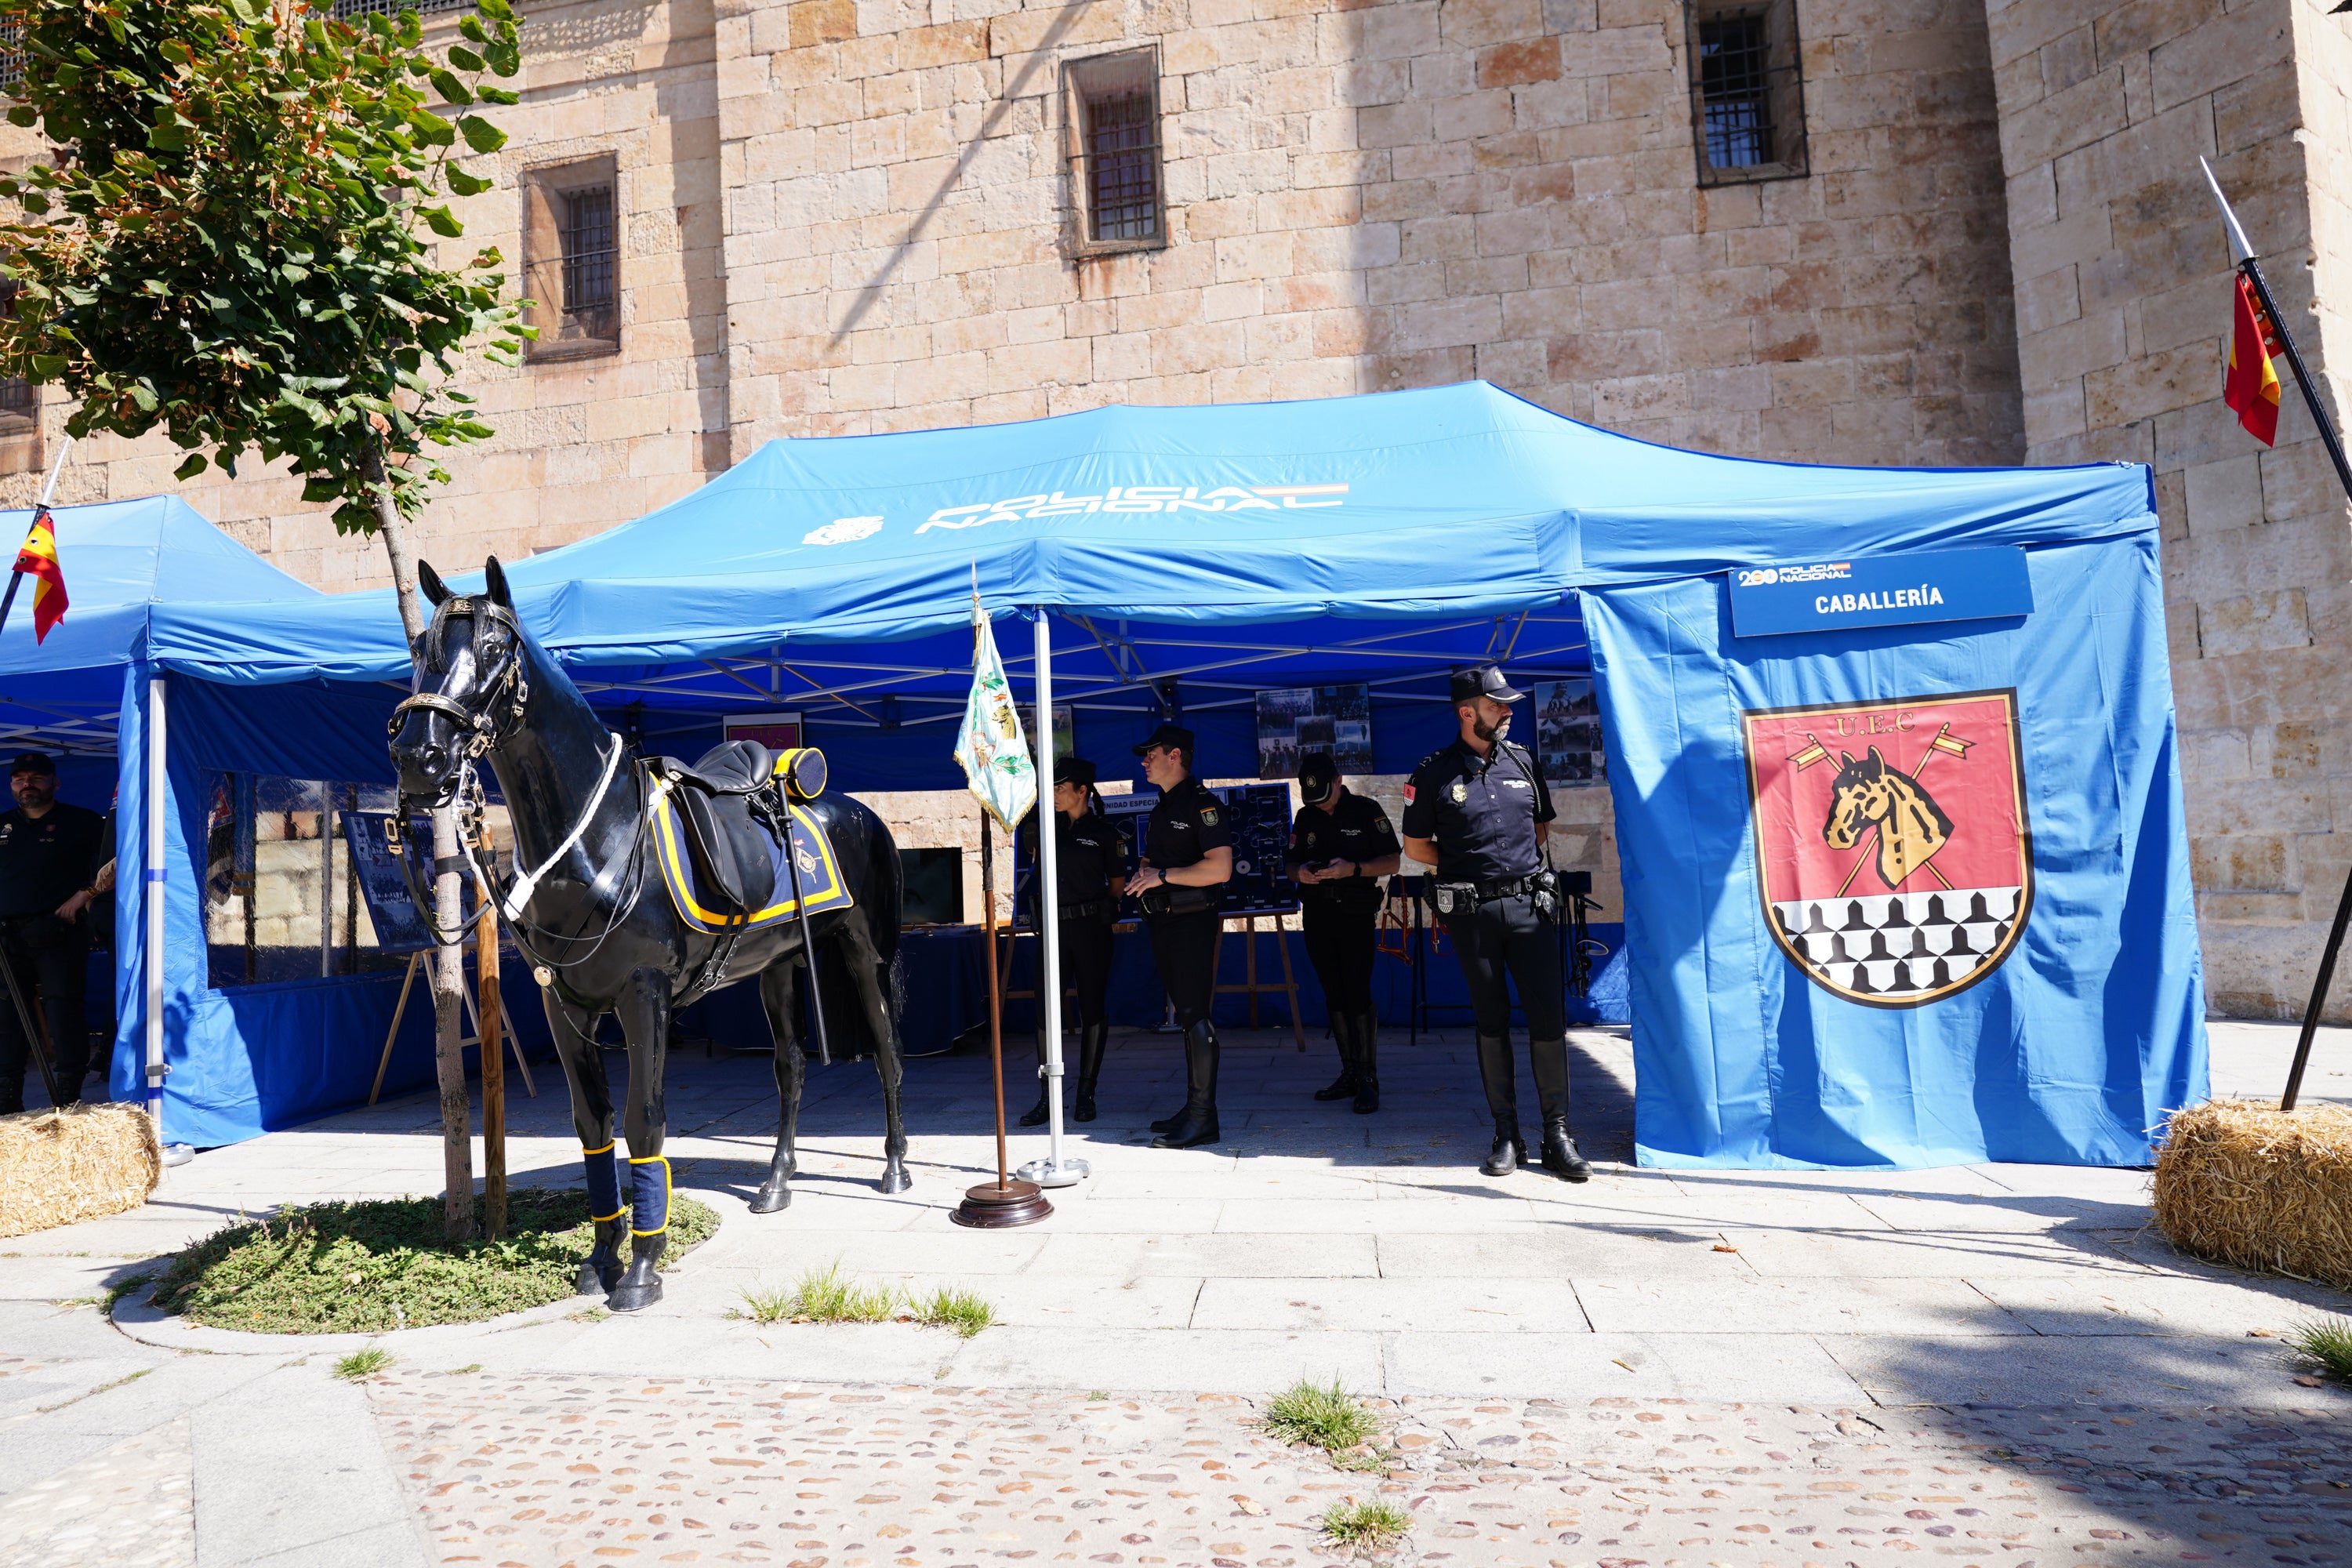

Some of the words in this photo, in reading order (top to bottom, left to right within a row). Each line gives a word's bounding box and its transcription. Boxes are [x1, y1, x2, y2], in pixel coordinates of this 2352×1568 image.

[913, 495, 1343, 535] NACIONAL
[927, 485, 1257, 521] POLICIA
[1779, 563, 1836, 575] POLICIA
[1779, 571, 1852, 583] NACIONAL
[1815, 583, 1944, 614] CABALLERÍA
[1835, 713, 1915, 738] U.E.C
